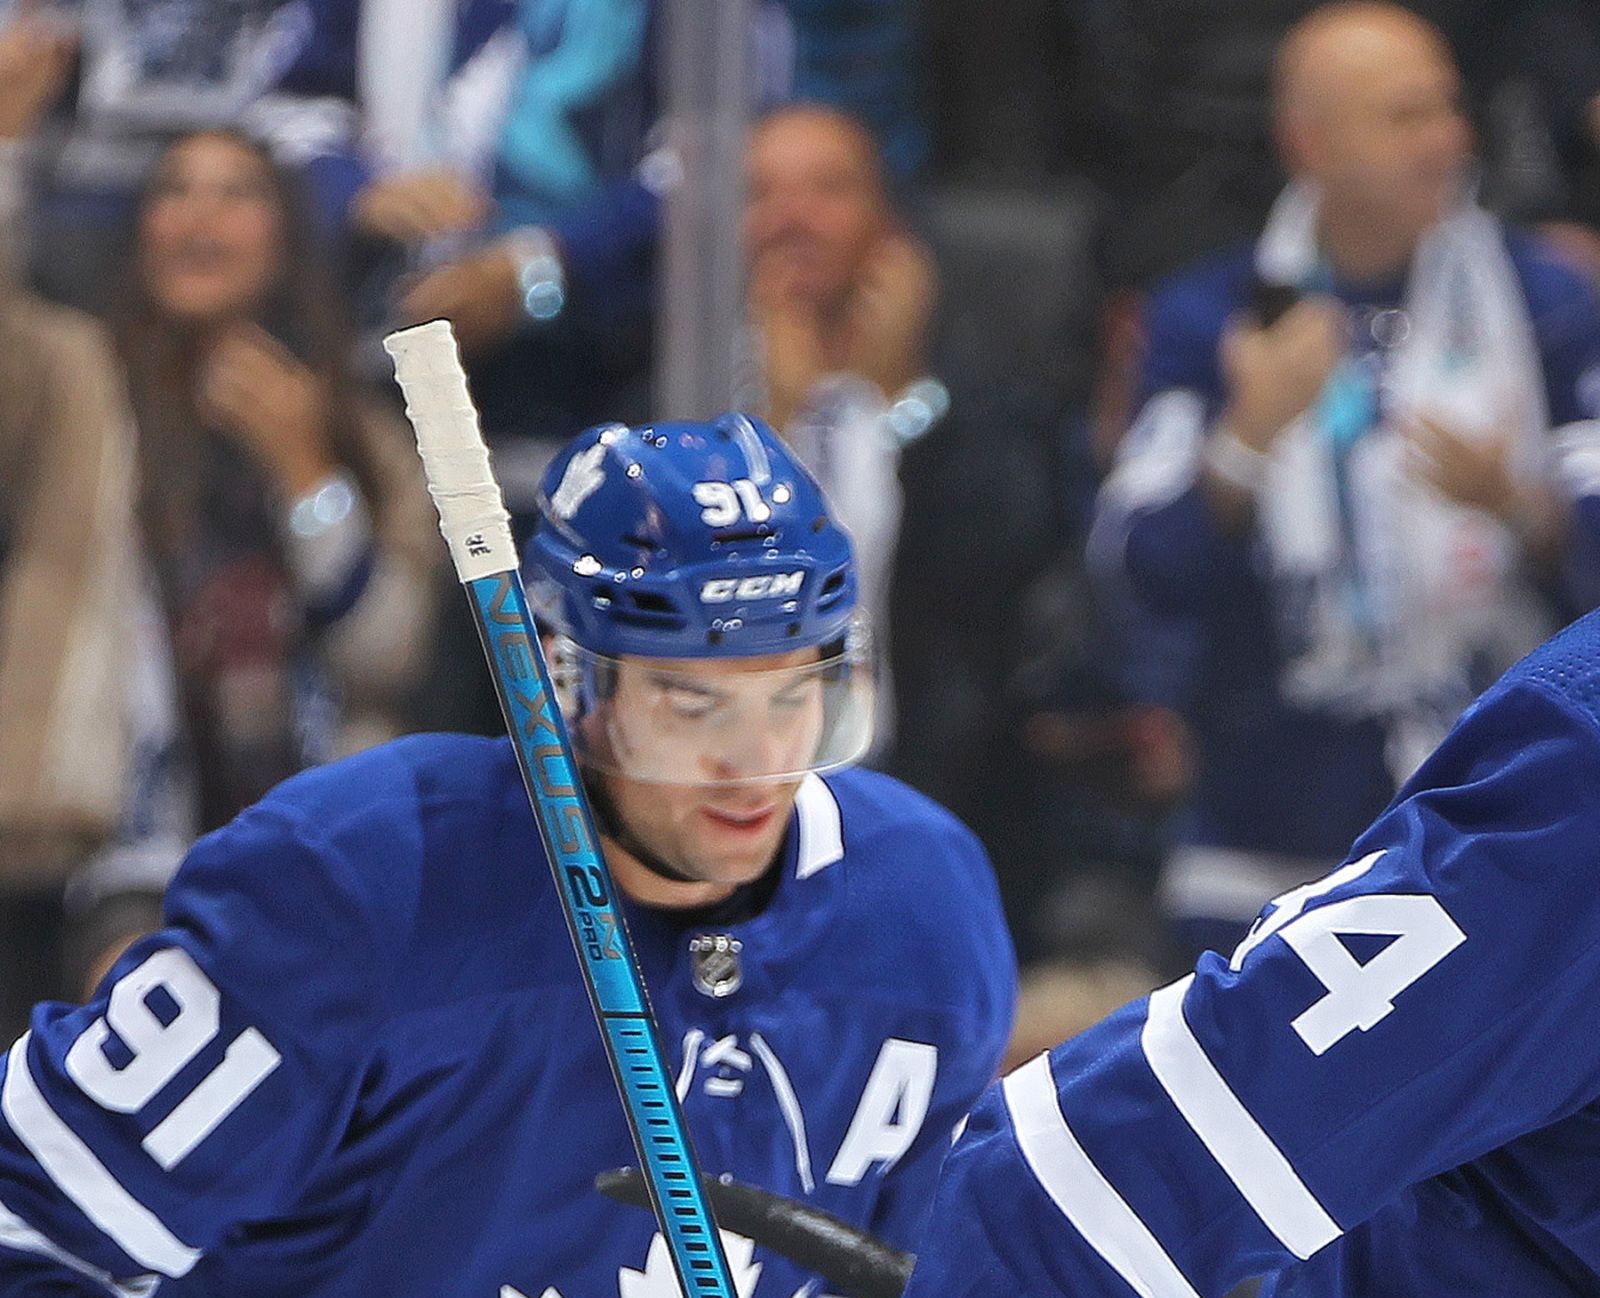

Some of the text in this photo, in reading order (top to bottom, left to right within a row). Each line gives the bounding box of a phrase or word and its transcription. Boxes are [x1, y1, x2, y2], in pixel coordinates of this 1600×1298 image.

[691, 477, 771, 527] 91
[700, 570, 805, 603] CCM
[489, 571, 601, 854] NEXUS
[64, 946, 283, 1172] 91
[825, 1037, 939, 1188] A
